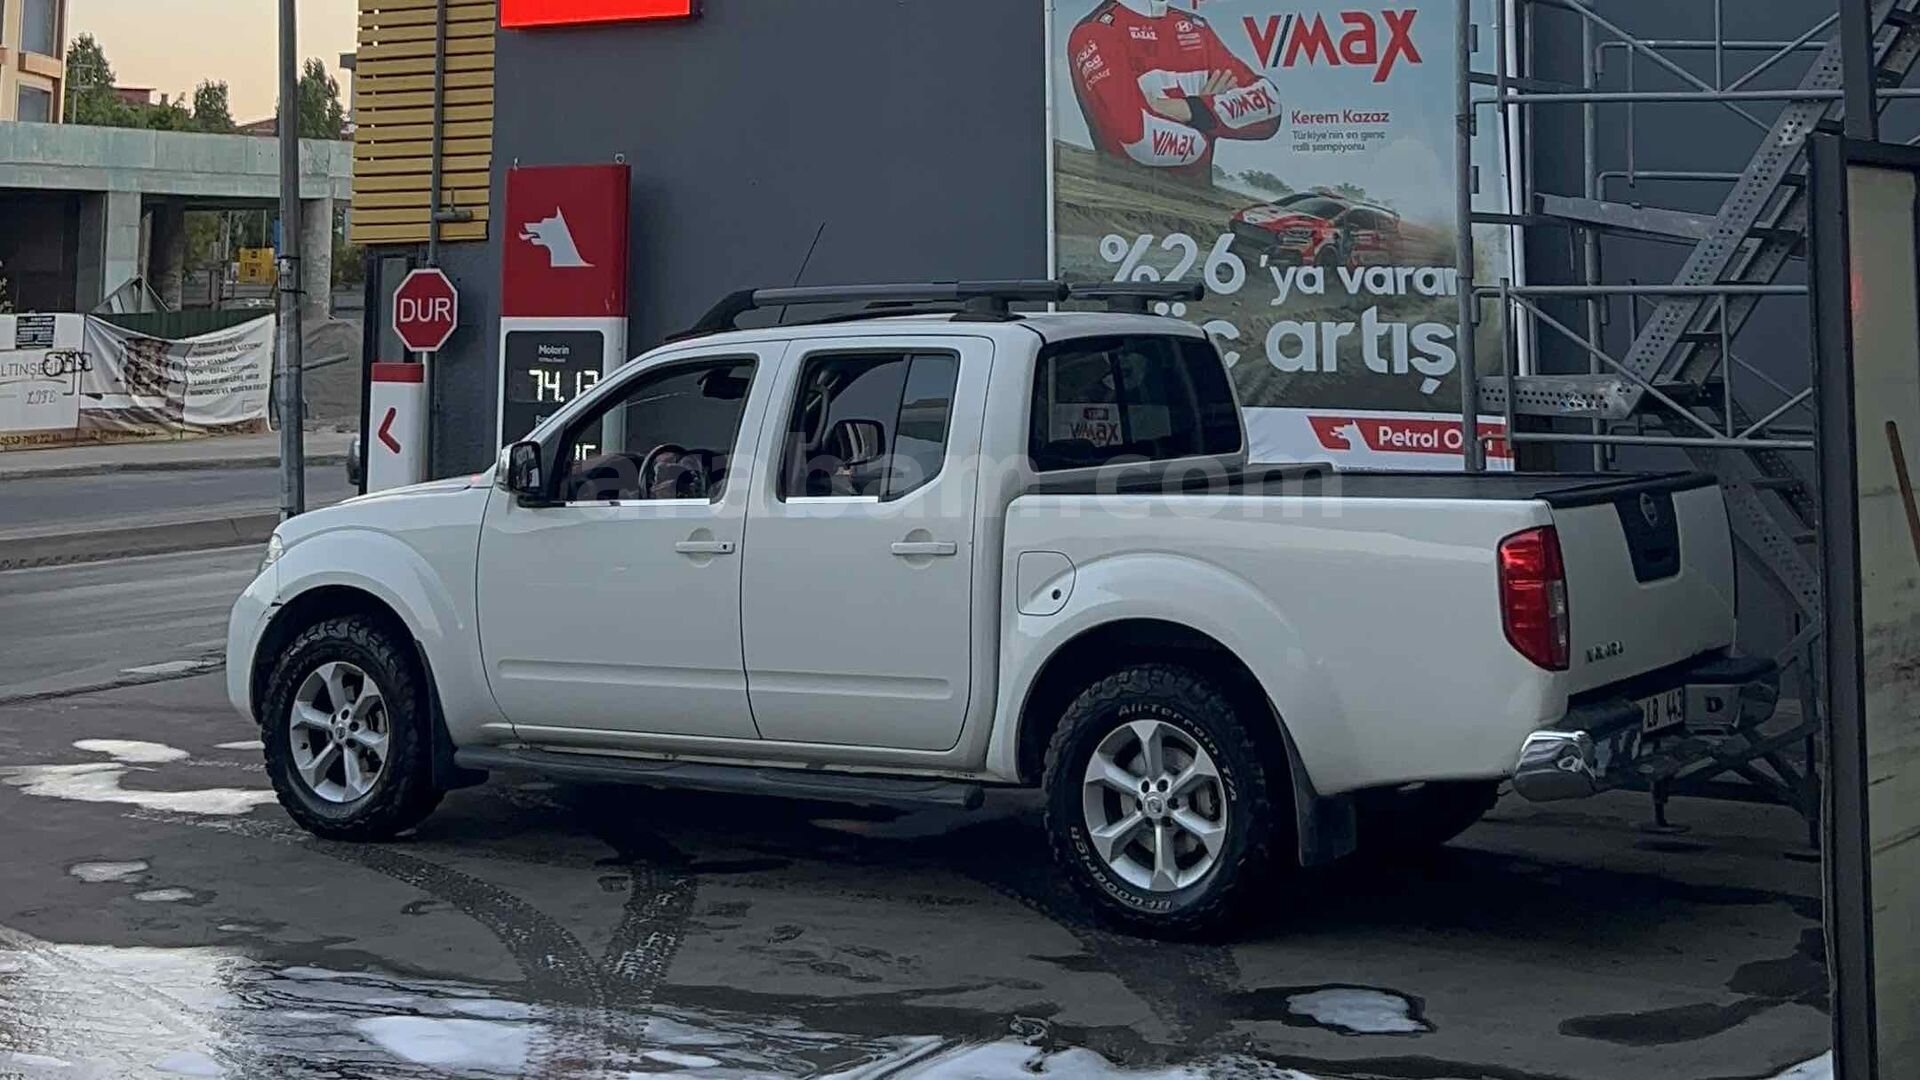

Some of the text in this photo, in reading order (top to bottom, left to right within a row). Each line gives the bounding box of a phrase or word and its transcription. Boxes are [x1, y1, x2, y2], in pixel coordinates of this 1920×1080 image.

[1292, 110, 1390, 124] Kerem Kazaz
[1100, 233, 1246, 294] %26
[400, 297, 451, 322] DUR
[1265, 305, 1462, 394] artış
[1378, 425, 1439, 448] Petrol
